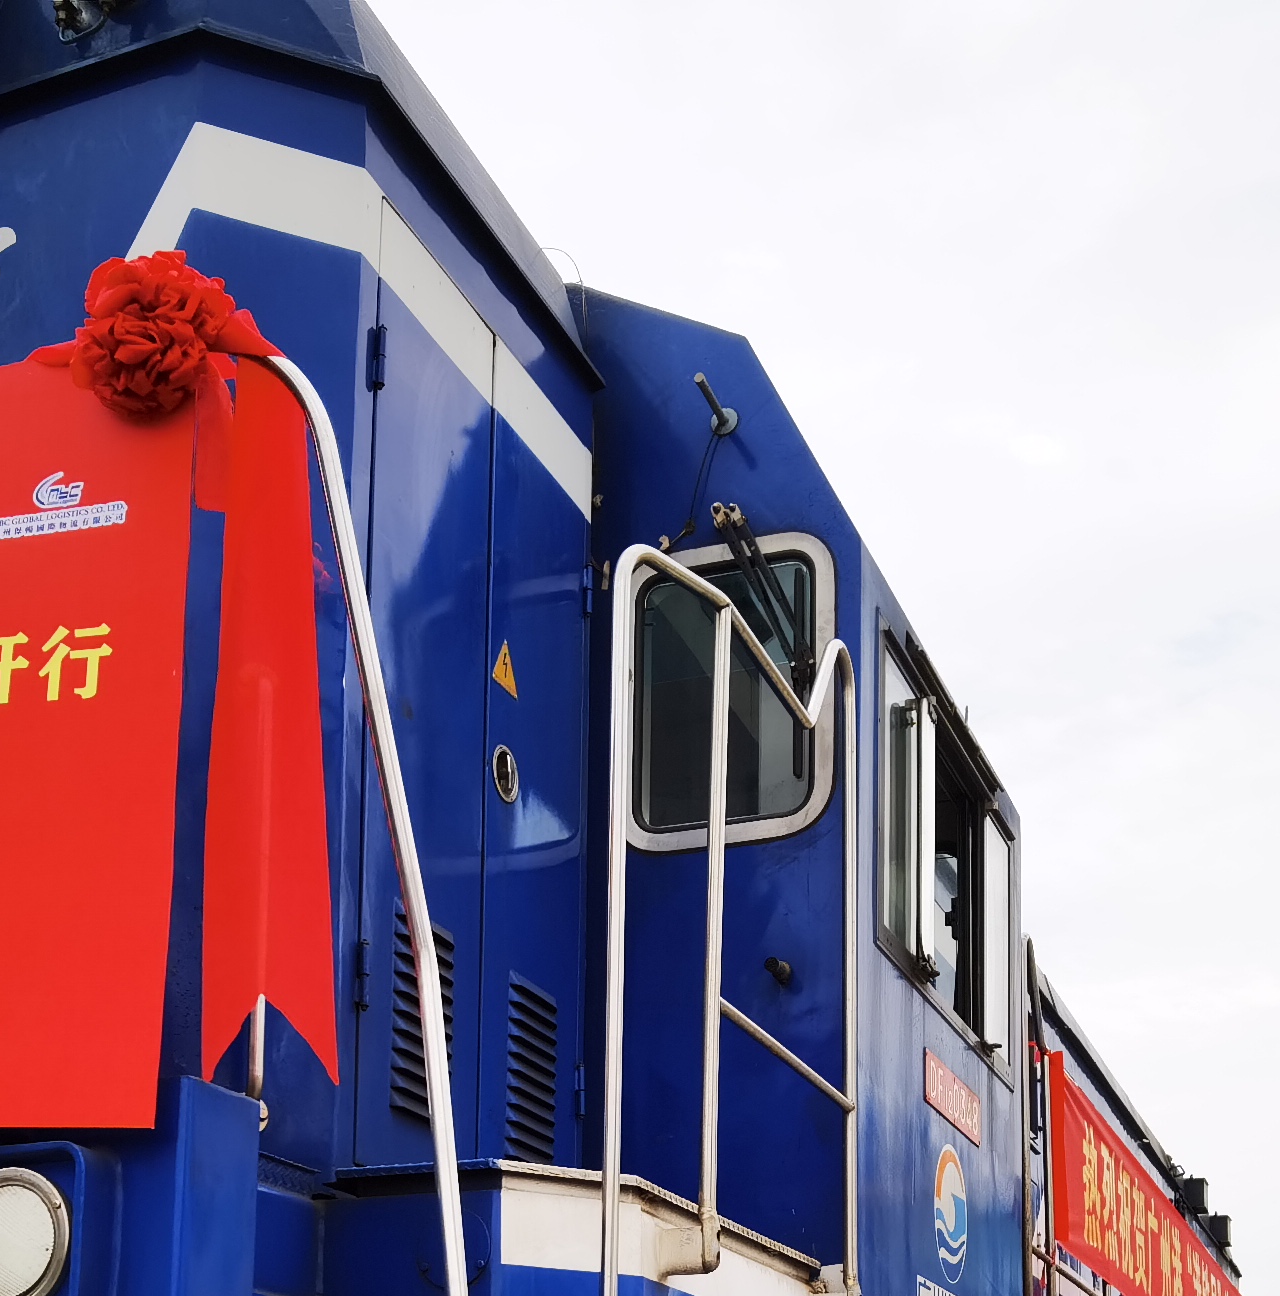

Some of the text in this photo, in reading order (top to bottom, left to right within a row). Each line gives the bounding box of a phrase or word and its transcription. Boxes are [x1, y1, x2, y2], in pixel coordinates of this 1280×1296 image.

[11, 514, 44, 525] GLOBAL
[46, 508, 89, 520] LOGISTICS
[929, 1059, 979, 1137] DF120348
